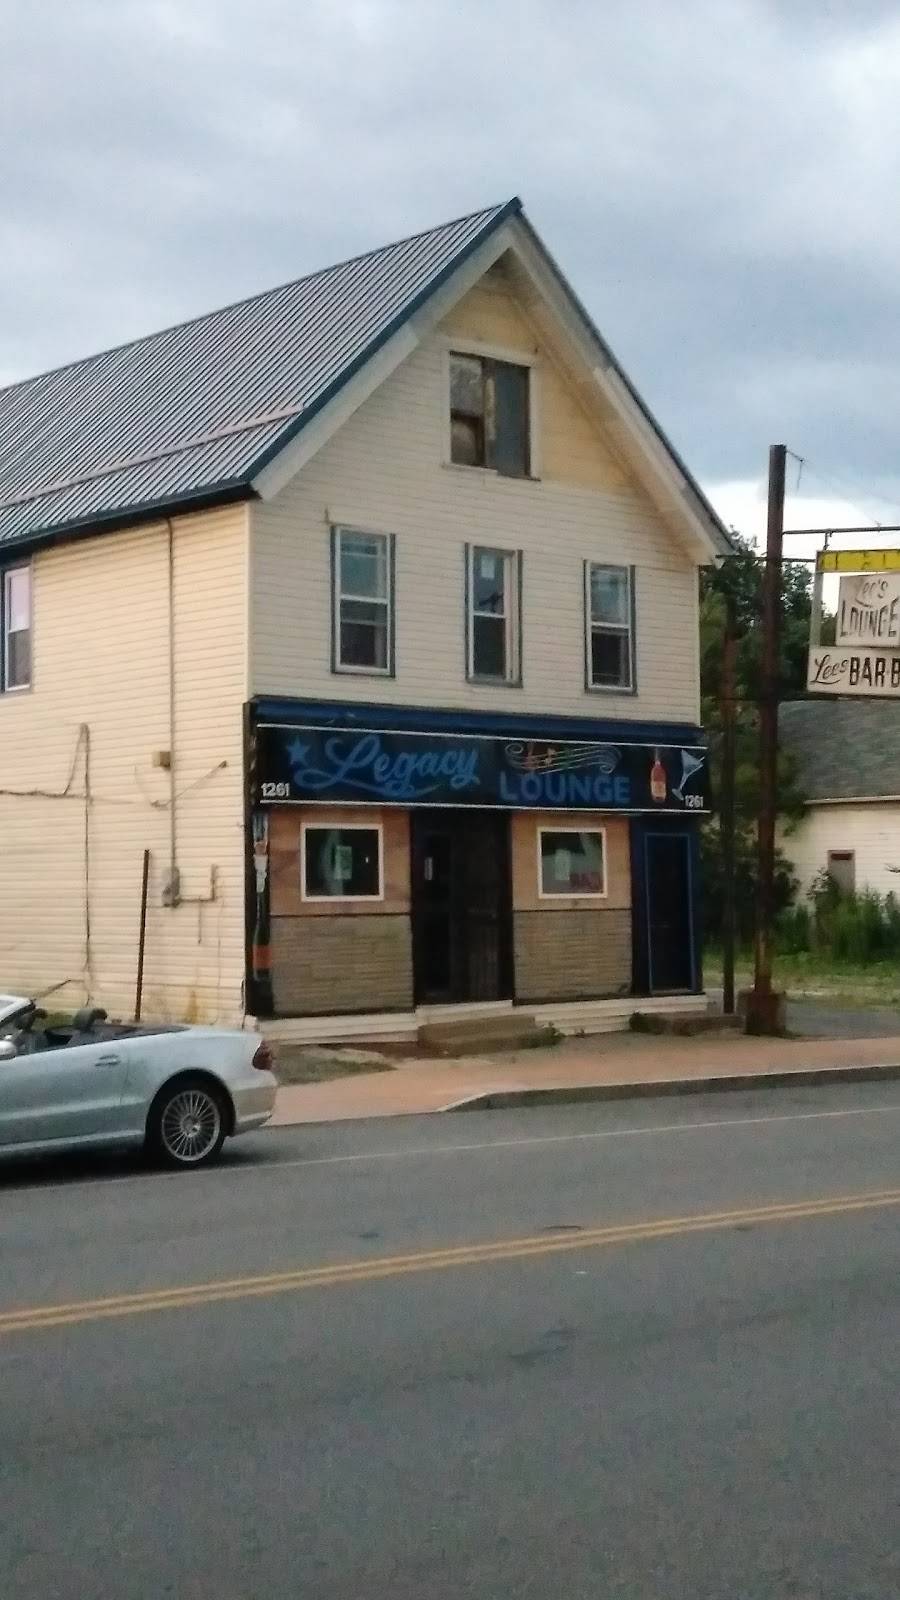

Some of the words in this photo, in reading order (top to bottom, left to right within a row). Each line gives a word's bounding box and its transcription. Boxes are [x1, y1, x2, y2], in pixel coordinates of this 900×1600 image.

[293, 733, 481, 798] Legacy
[260, 781, 291, 797] 1261
[499, 770, 631, 803] LOUNGE
[684, 794, 705, 808] 1261
